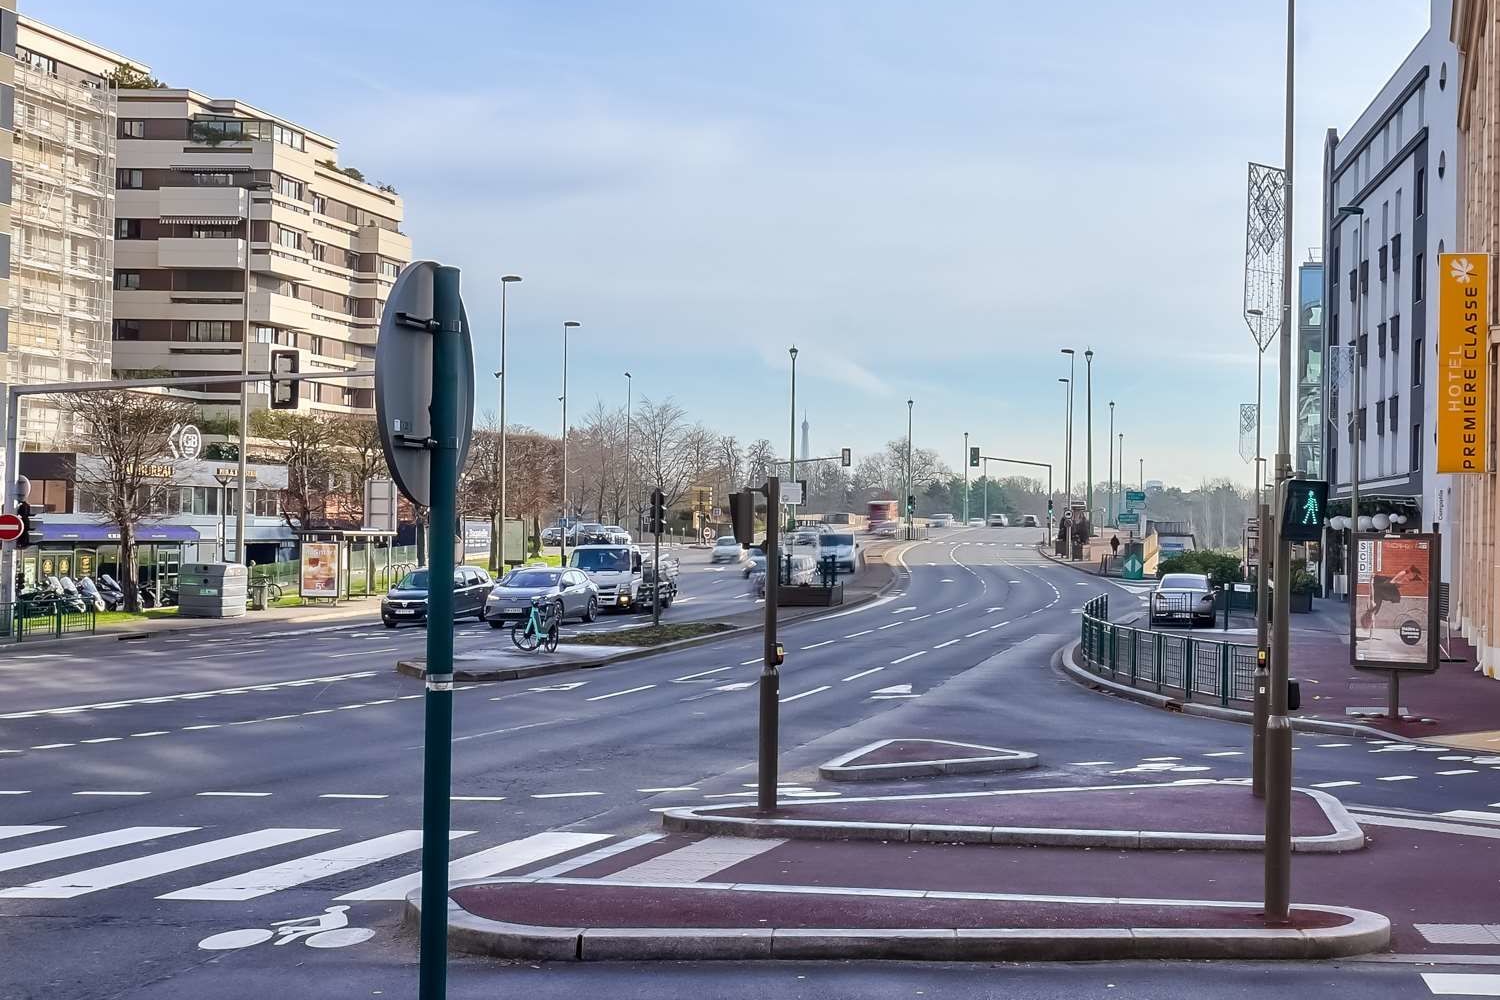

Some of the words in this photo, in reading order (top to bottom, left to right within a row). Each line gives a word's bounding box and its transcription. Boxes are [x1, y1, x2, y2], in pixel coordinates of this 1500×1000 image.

[1464, 286, 1478, 360] CLASSE
[1448, 344, 1463, 412] HOTEL
[1463, 368, 1477, 469] PREMIERE
